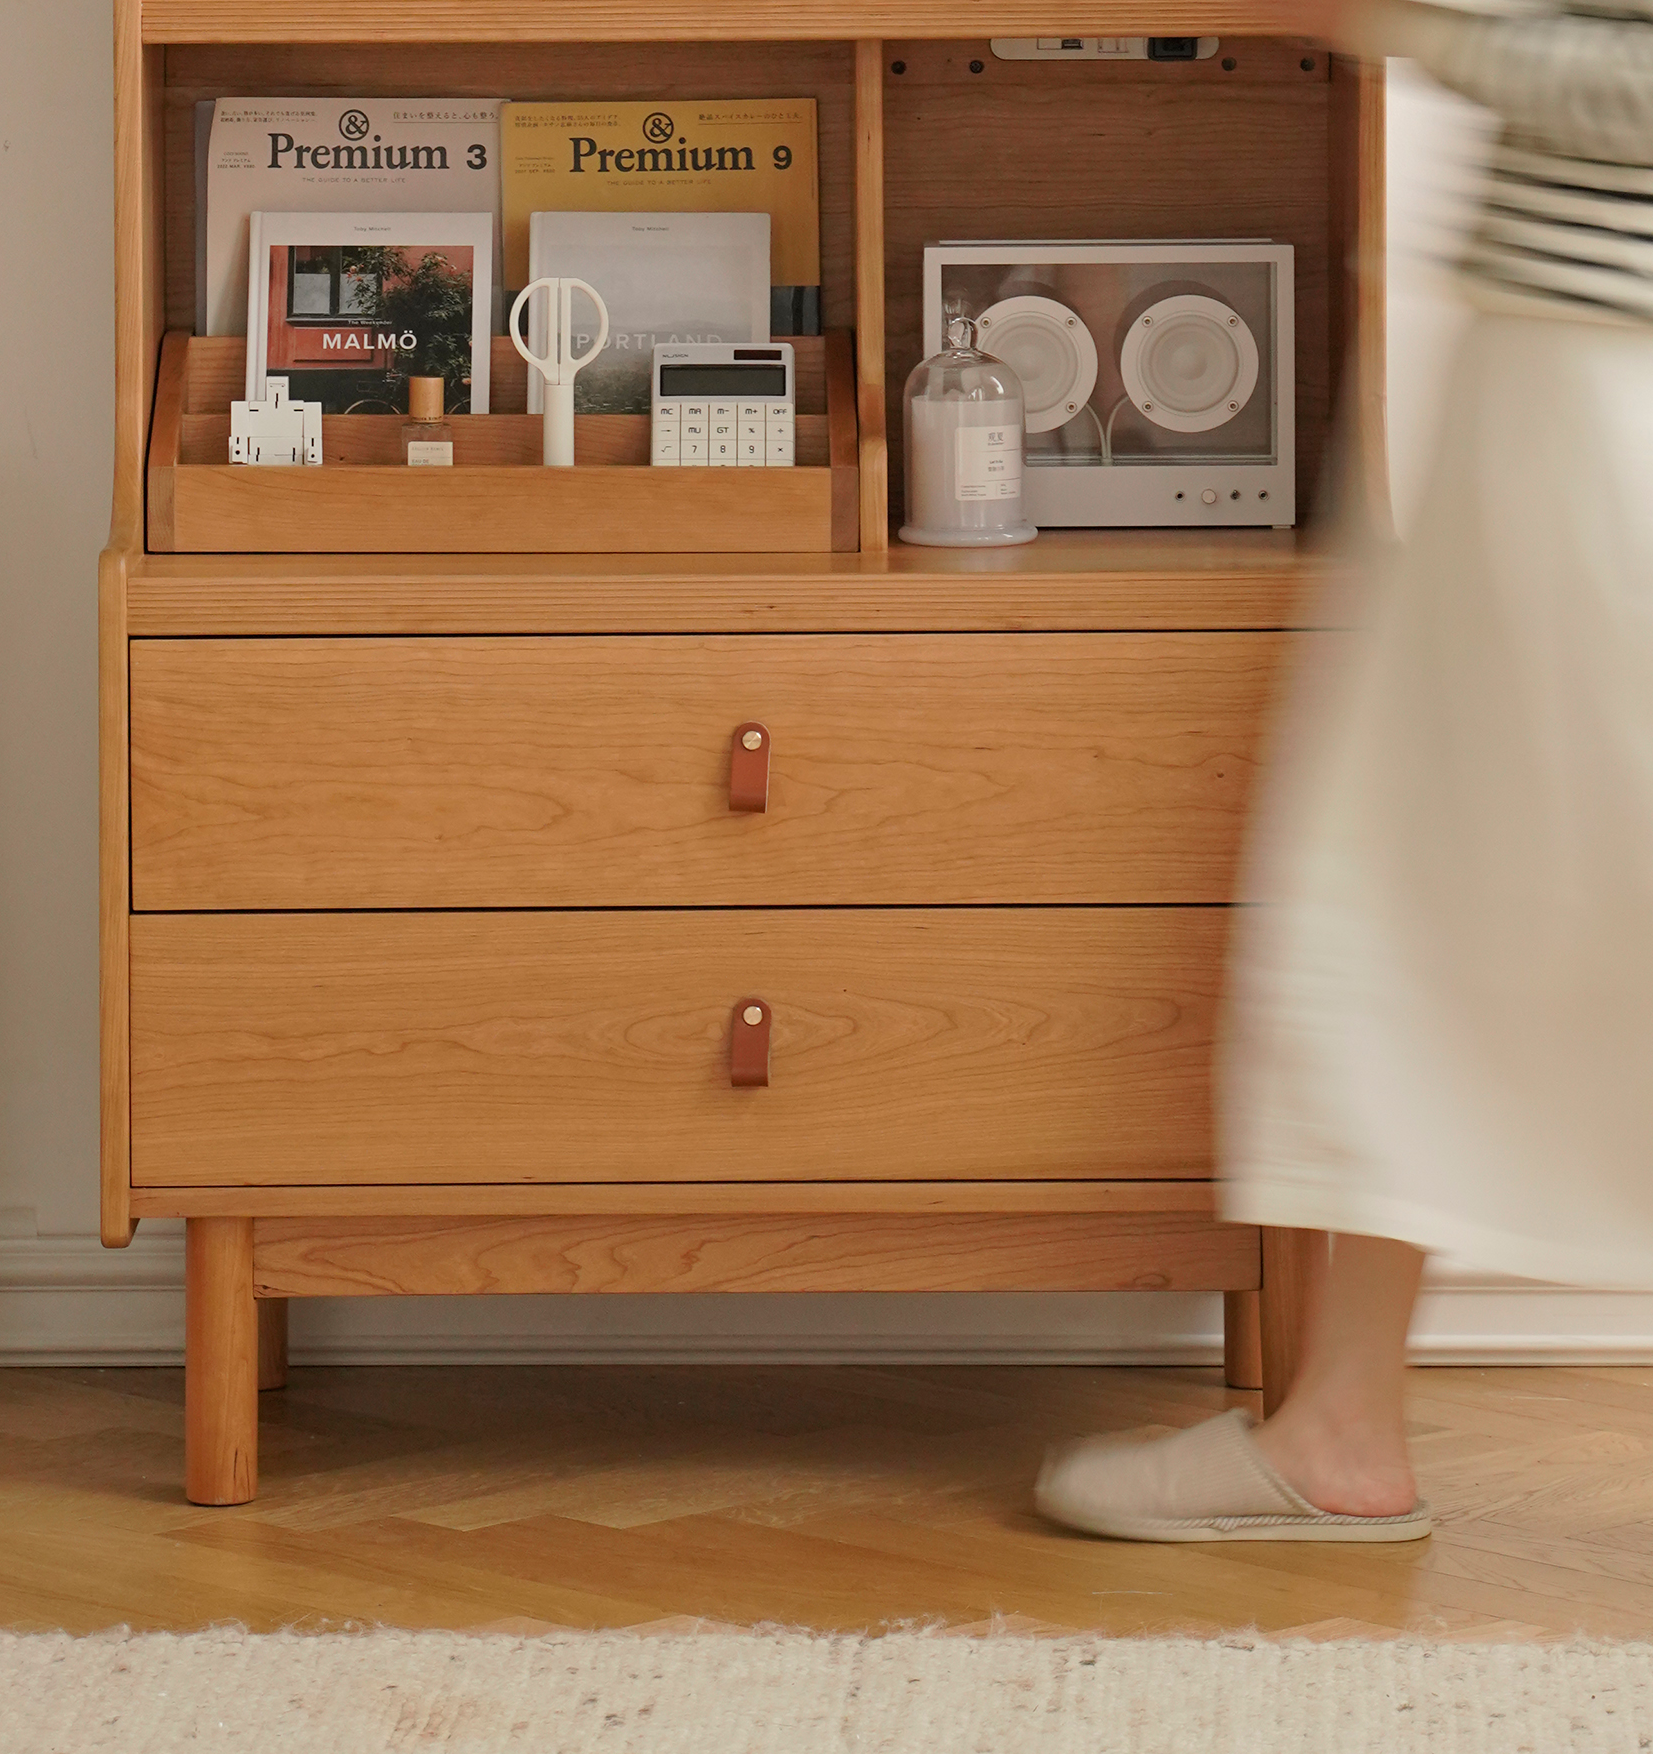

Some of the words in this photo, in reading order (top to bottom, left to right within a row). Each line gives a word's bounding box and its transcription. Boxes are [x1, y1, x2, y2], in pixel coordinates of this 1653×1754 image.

[342, 112, 368, 138] &
[645, 115, 672, 140] &
[267, 133, 450, 170] Premium
[466, 143, 487, 171] 3
[568, 137, 756, 172] Premium
[773, 145, 792, 170] 9
[322, 330, 418, 350] MALMÖ
[716, 426, 729, 434] GT
[691, 445, 697, 453] 7
[720, 445, 726, 453] 8
[748, 445, 755, 453] 9
